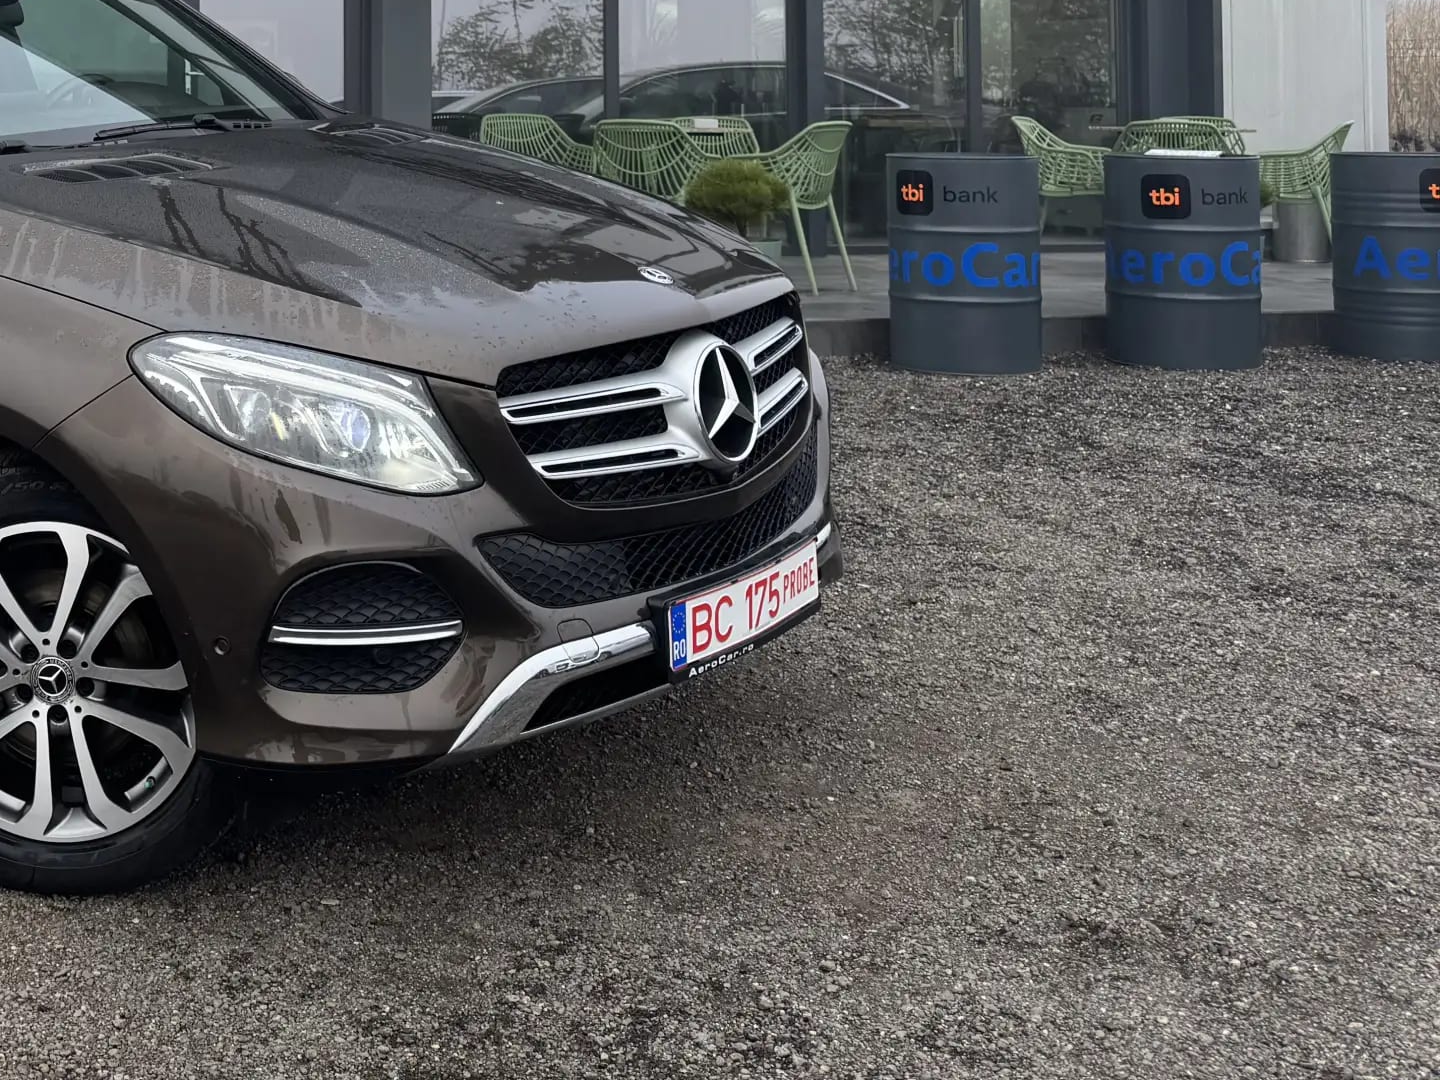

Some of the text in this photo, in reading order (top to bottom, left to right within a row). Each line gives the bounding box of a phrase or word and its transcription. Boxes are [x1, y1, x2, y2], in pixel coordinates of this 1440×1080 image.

[900, 183, 999, 204] tbi bank
[1149, 187, 1249, 206] tbi bank
[1352, 235, 1440, 280] Ae
[691, 556, 816, 654] BC 175 PROBE
[673, 638, 686, 661] RO
[688, 643, 755, 678] AeroCar.ro
